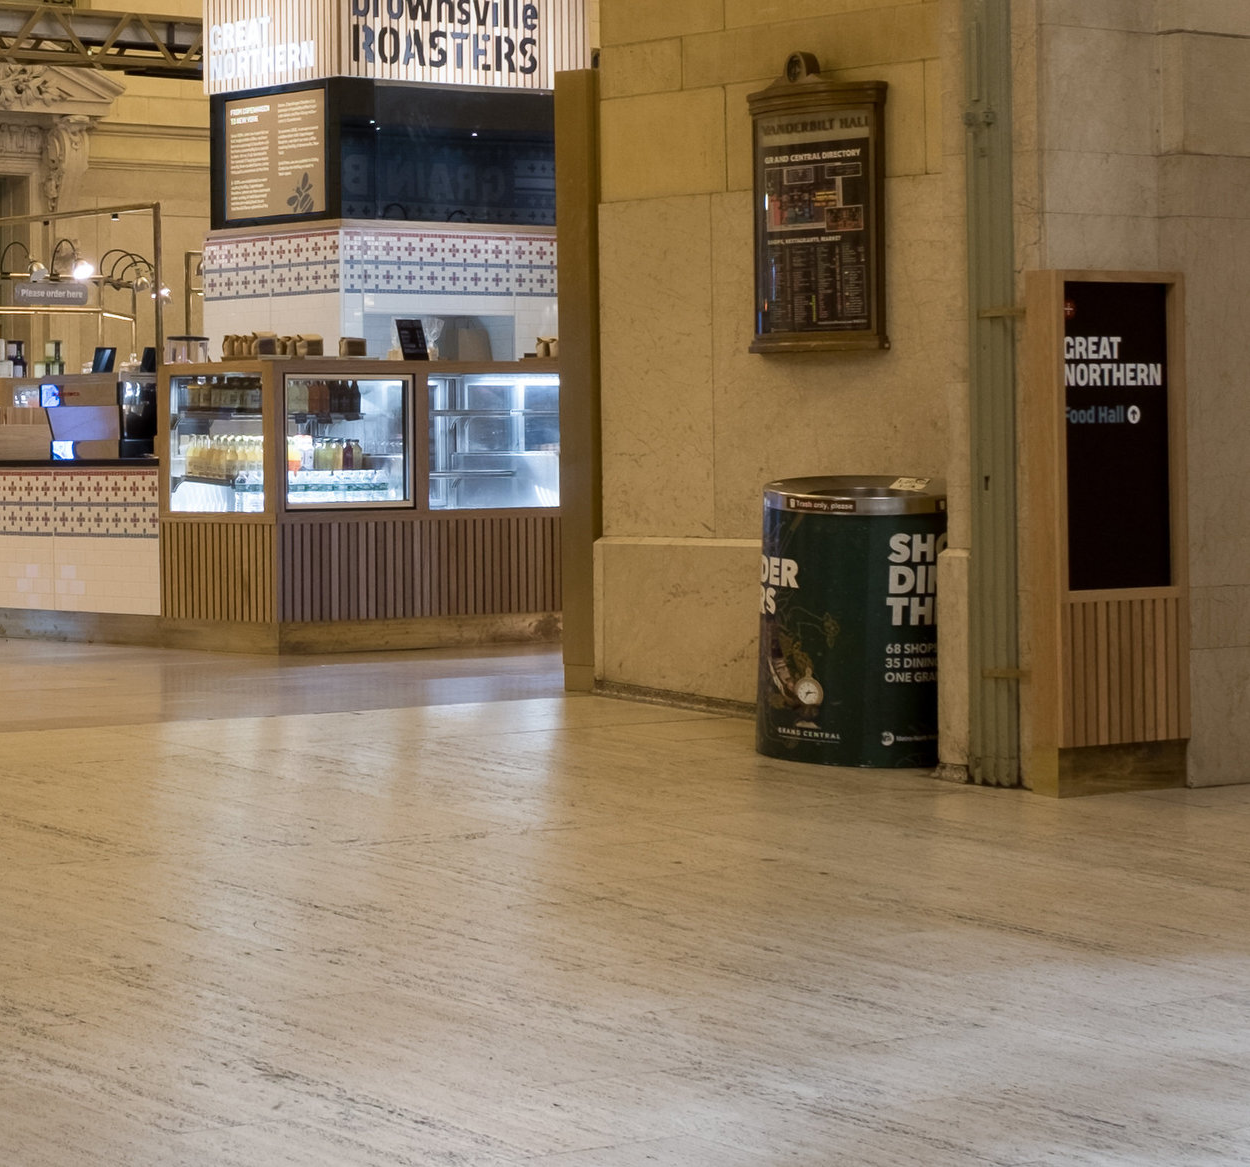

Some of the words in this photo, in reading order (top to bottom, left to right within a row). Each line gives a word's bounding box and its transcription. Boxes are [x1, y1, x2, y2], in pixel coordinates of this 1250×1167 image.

[210, 16, 271, 51] GREAT
[352, 24, 538, 75] ROASTERS
[210, 41, 315, 81] NORTHERN
[765, 155, 789, 164] GRAND
[790, 152, 821, 162] CENTRAL
[822, 148, 861, 159] DIRECTORY
[21, 288, 45, 297] Please
[46, 289, 66, 298] order
[67, 290, 83, 298] here
[1064, 336, 1122, 360] GREAT
[1064, 363, 1162, 386] NORTHERN
[1098, 405, 1125, 424] Hall
[830, 503, 854, 511] please
[885, 597, 938, 626] TH
[885, 643, 901, 654] 68
[885, 658, 901, 668] 35
[884, 672, 912, 683] ONE
[914, 672, 937, 682] GRA
[803, 730, 841, 739] CENTRAL
